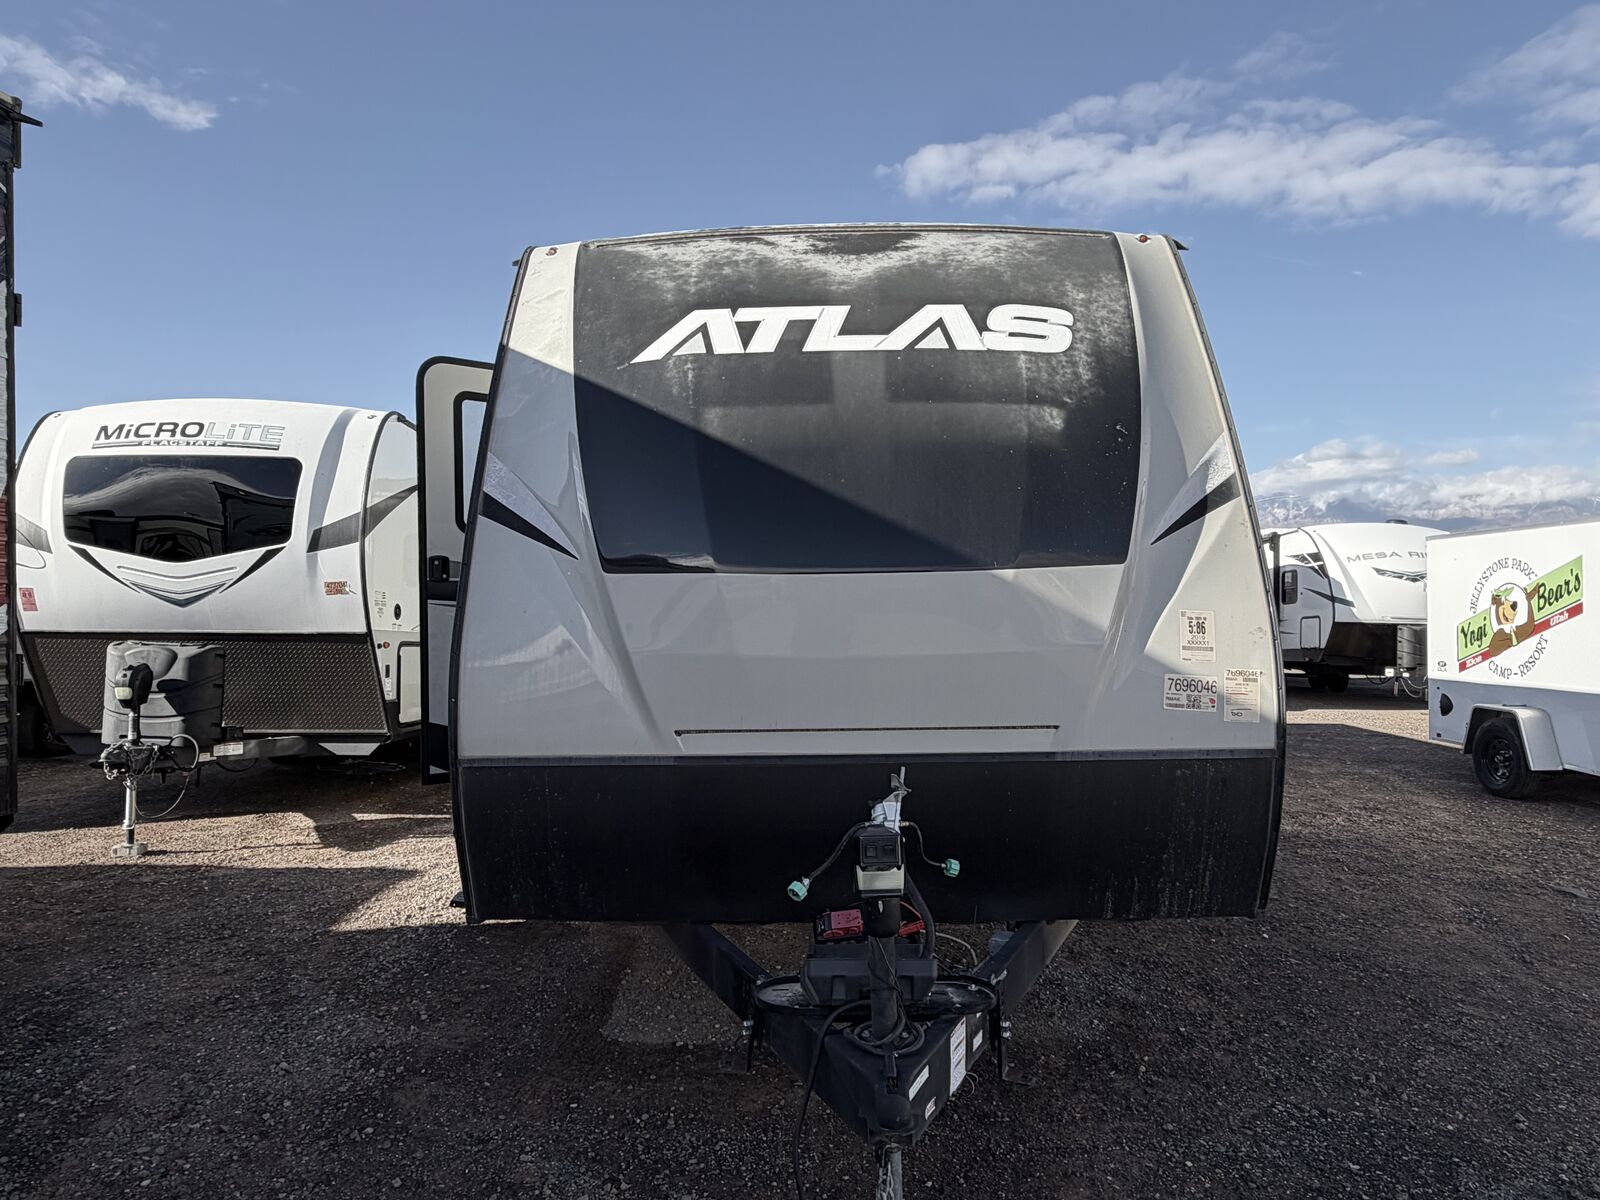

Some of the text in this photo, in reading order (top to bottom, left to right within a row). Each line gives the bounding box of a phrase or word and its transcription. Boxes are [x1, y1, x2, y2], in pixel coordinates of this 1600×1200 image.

[629, 303, 1075, 364] ATLAS
[1346, 551, 1427, 563] MESA RI
[1469, 557, 1510, 614] JELLYSTONE
[1536, 568, 1581, 613] Bear's
[1460, 616, 1488, 649] Yogi
[1549, 610, 1570, 627] Utah
[1167, 678, 1218, 694] 7696046
